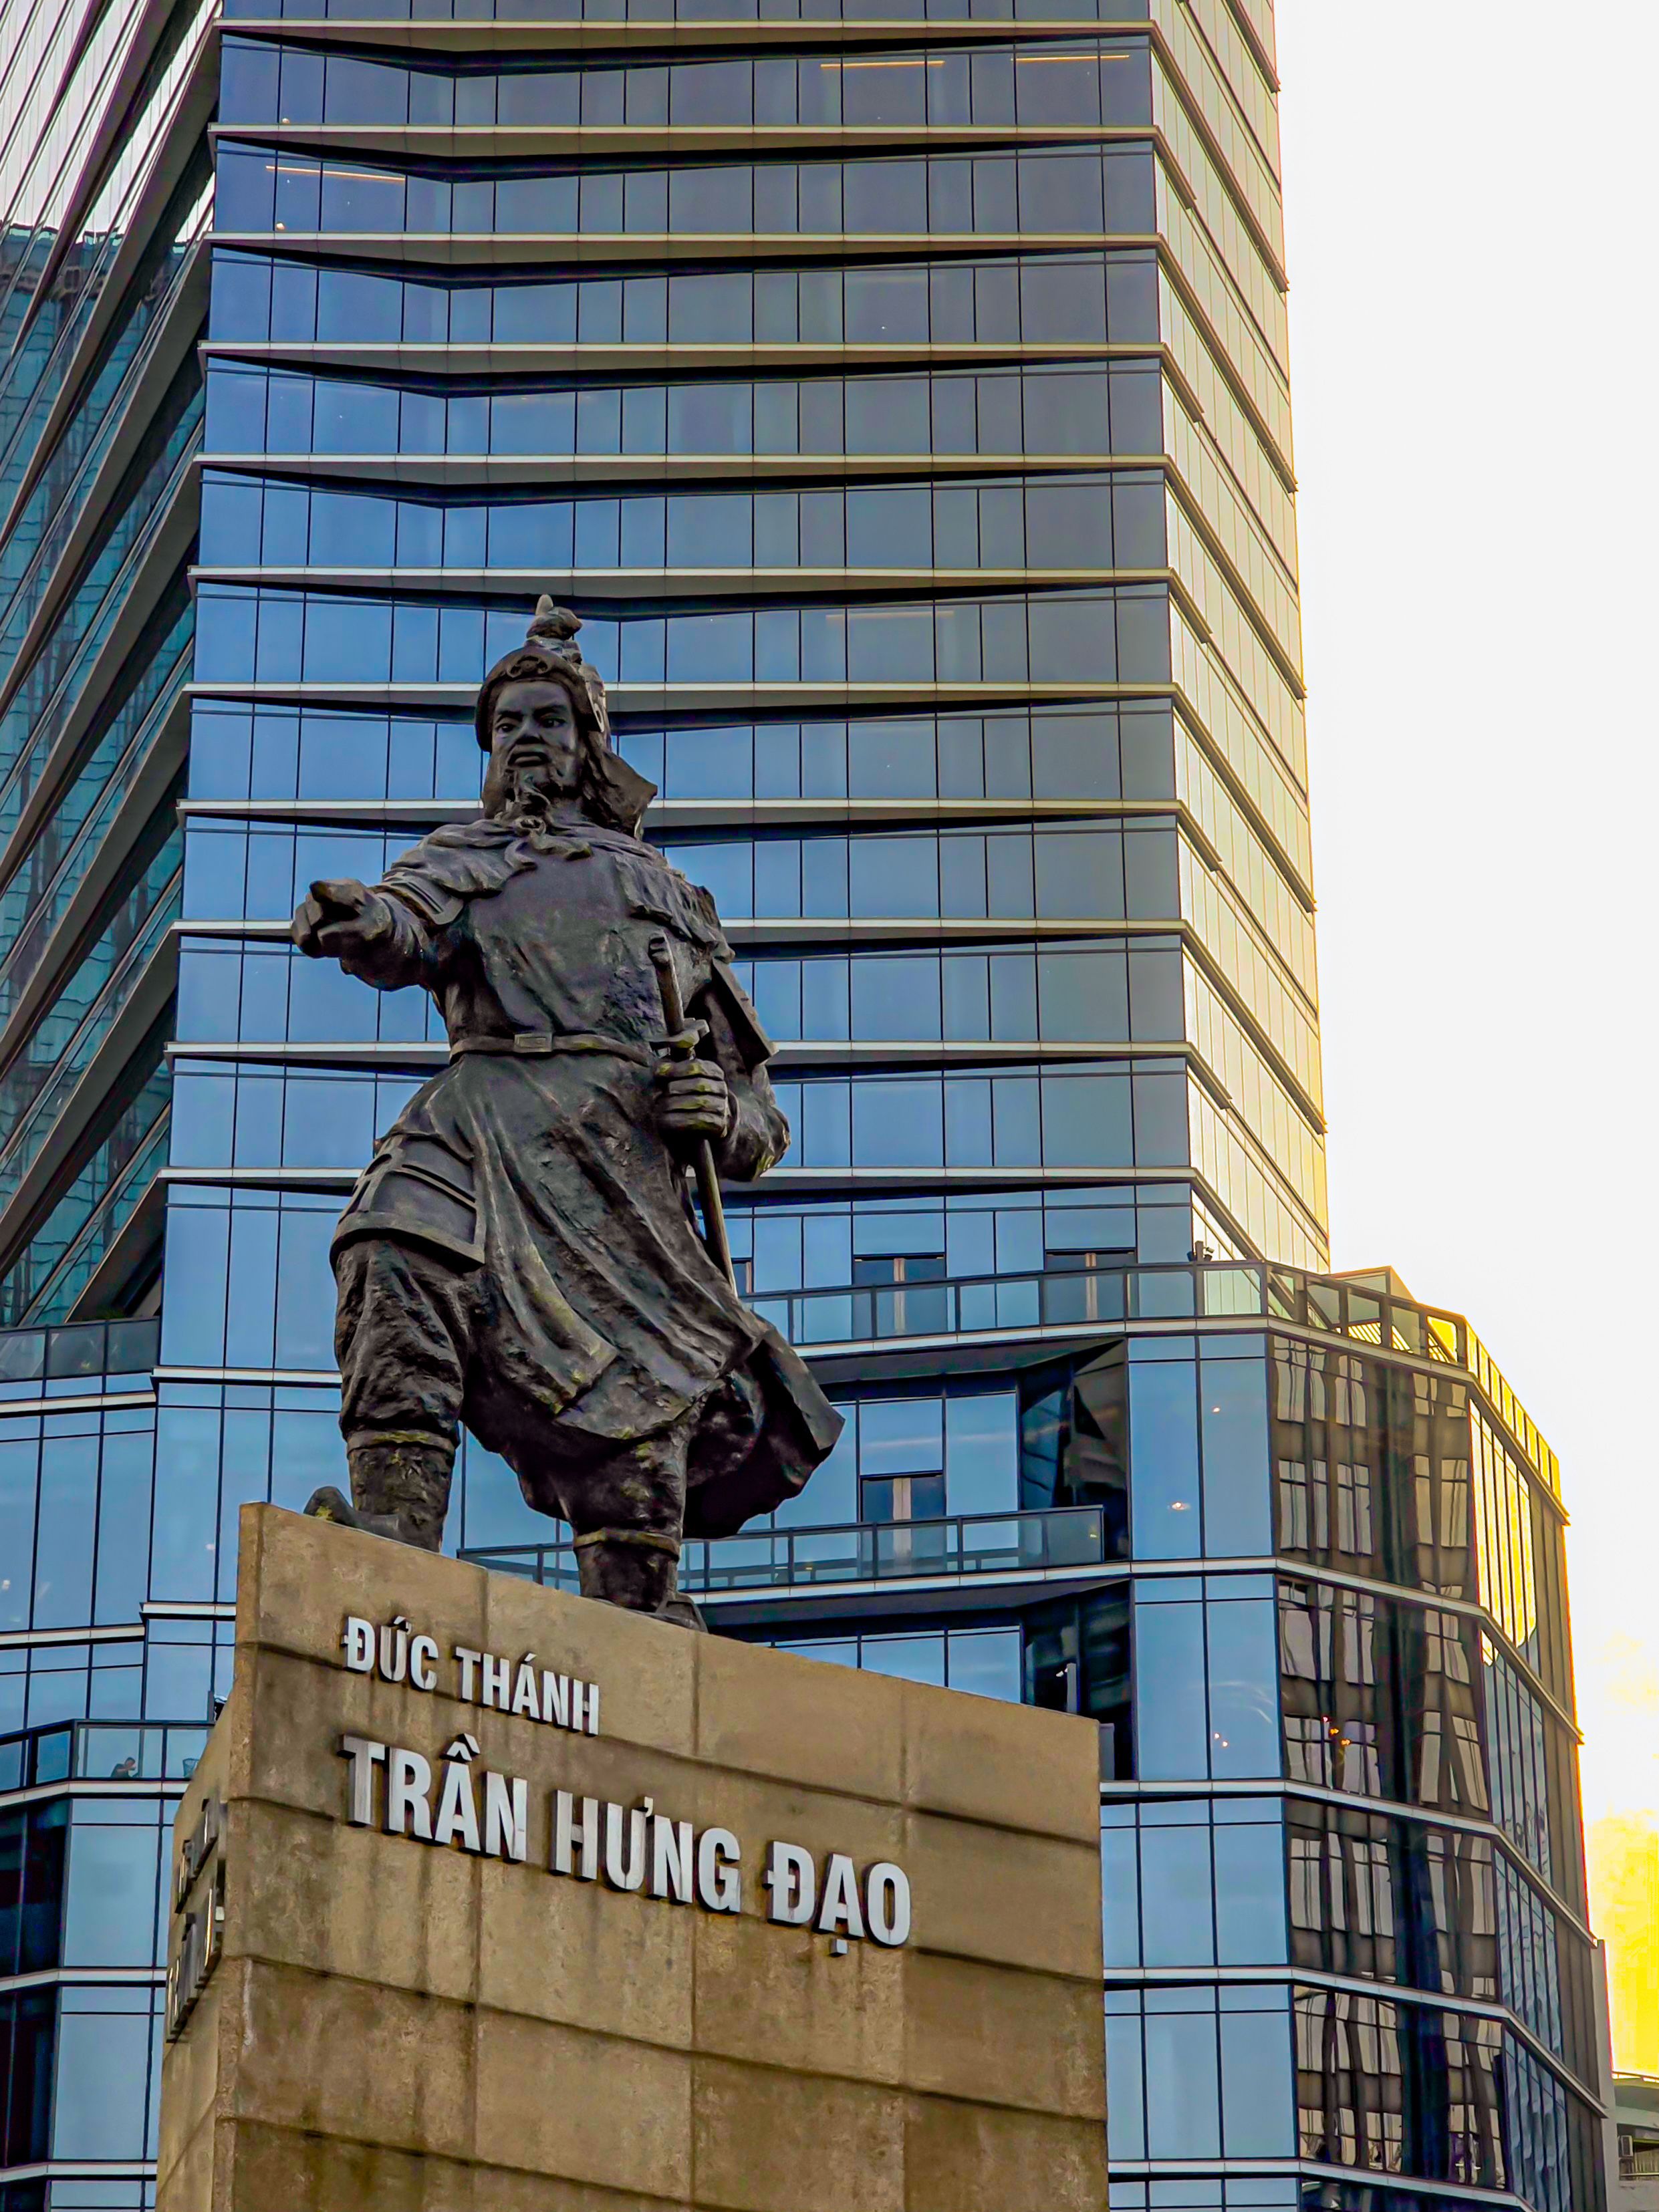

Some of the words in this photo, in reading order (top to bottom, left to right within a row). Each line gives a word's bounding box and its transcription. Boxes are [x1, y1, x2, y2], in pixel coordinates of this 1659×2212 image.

[342, 1615, 438, 1691] ĐỨC
[455, 1653, 600, 1736] THÁNH
[340, 1733, 528, 1862] TRẦN
[551, 1790, 741, 1913] HƯNG
[765, 1840, 911, 1956] ĐẠO
